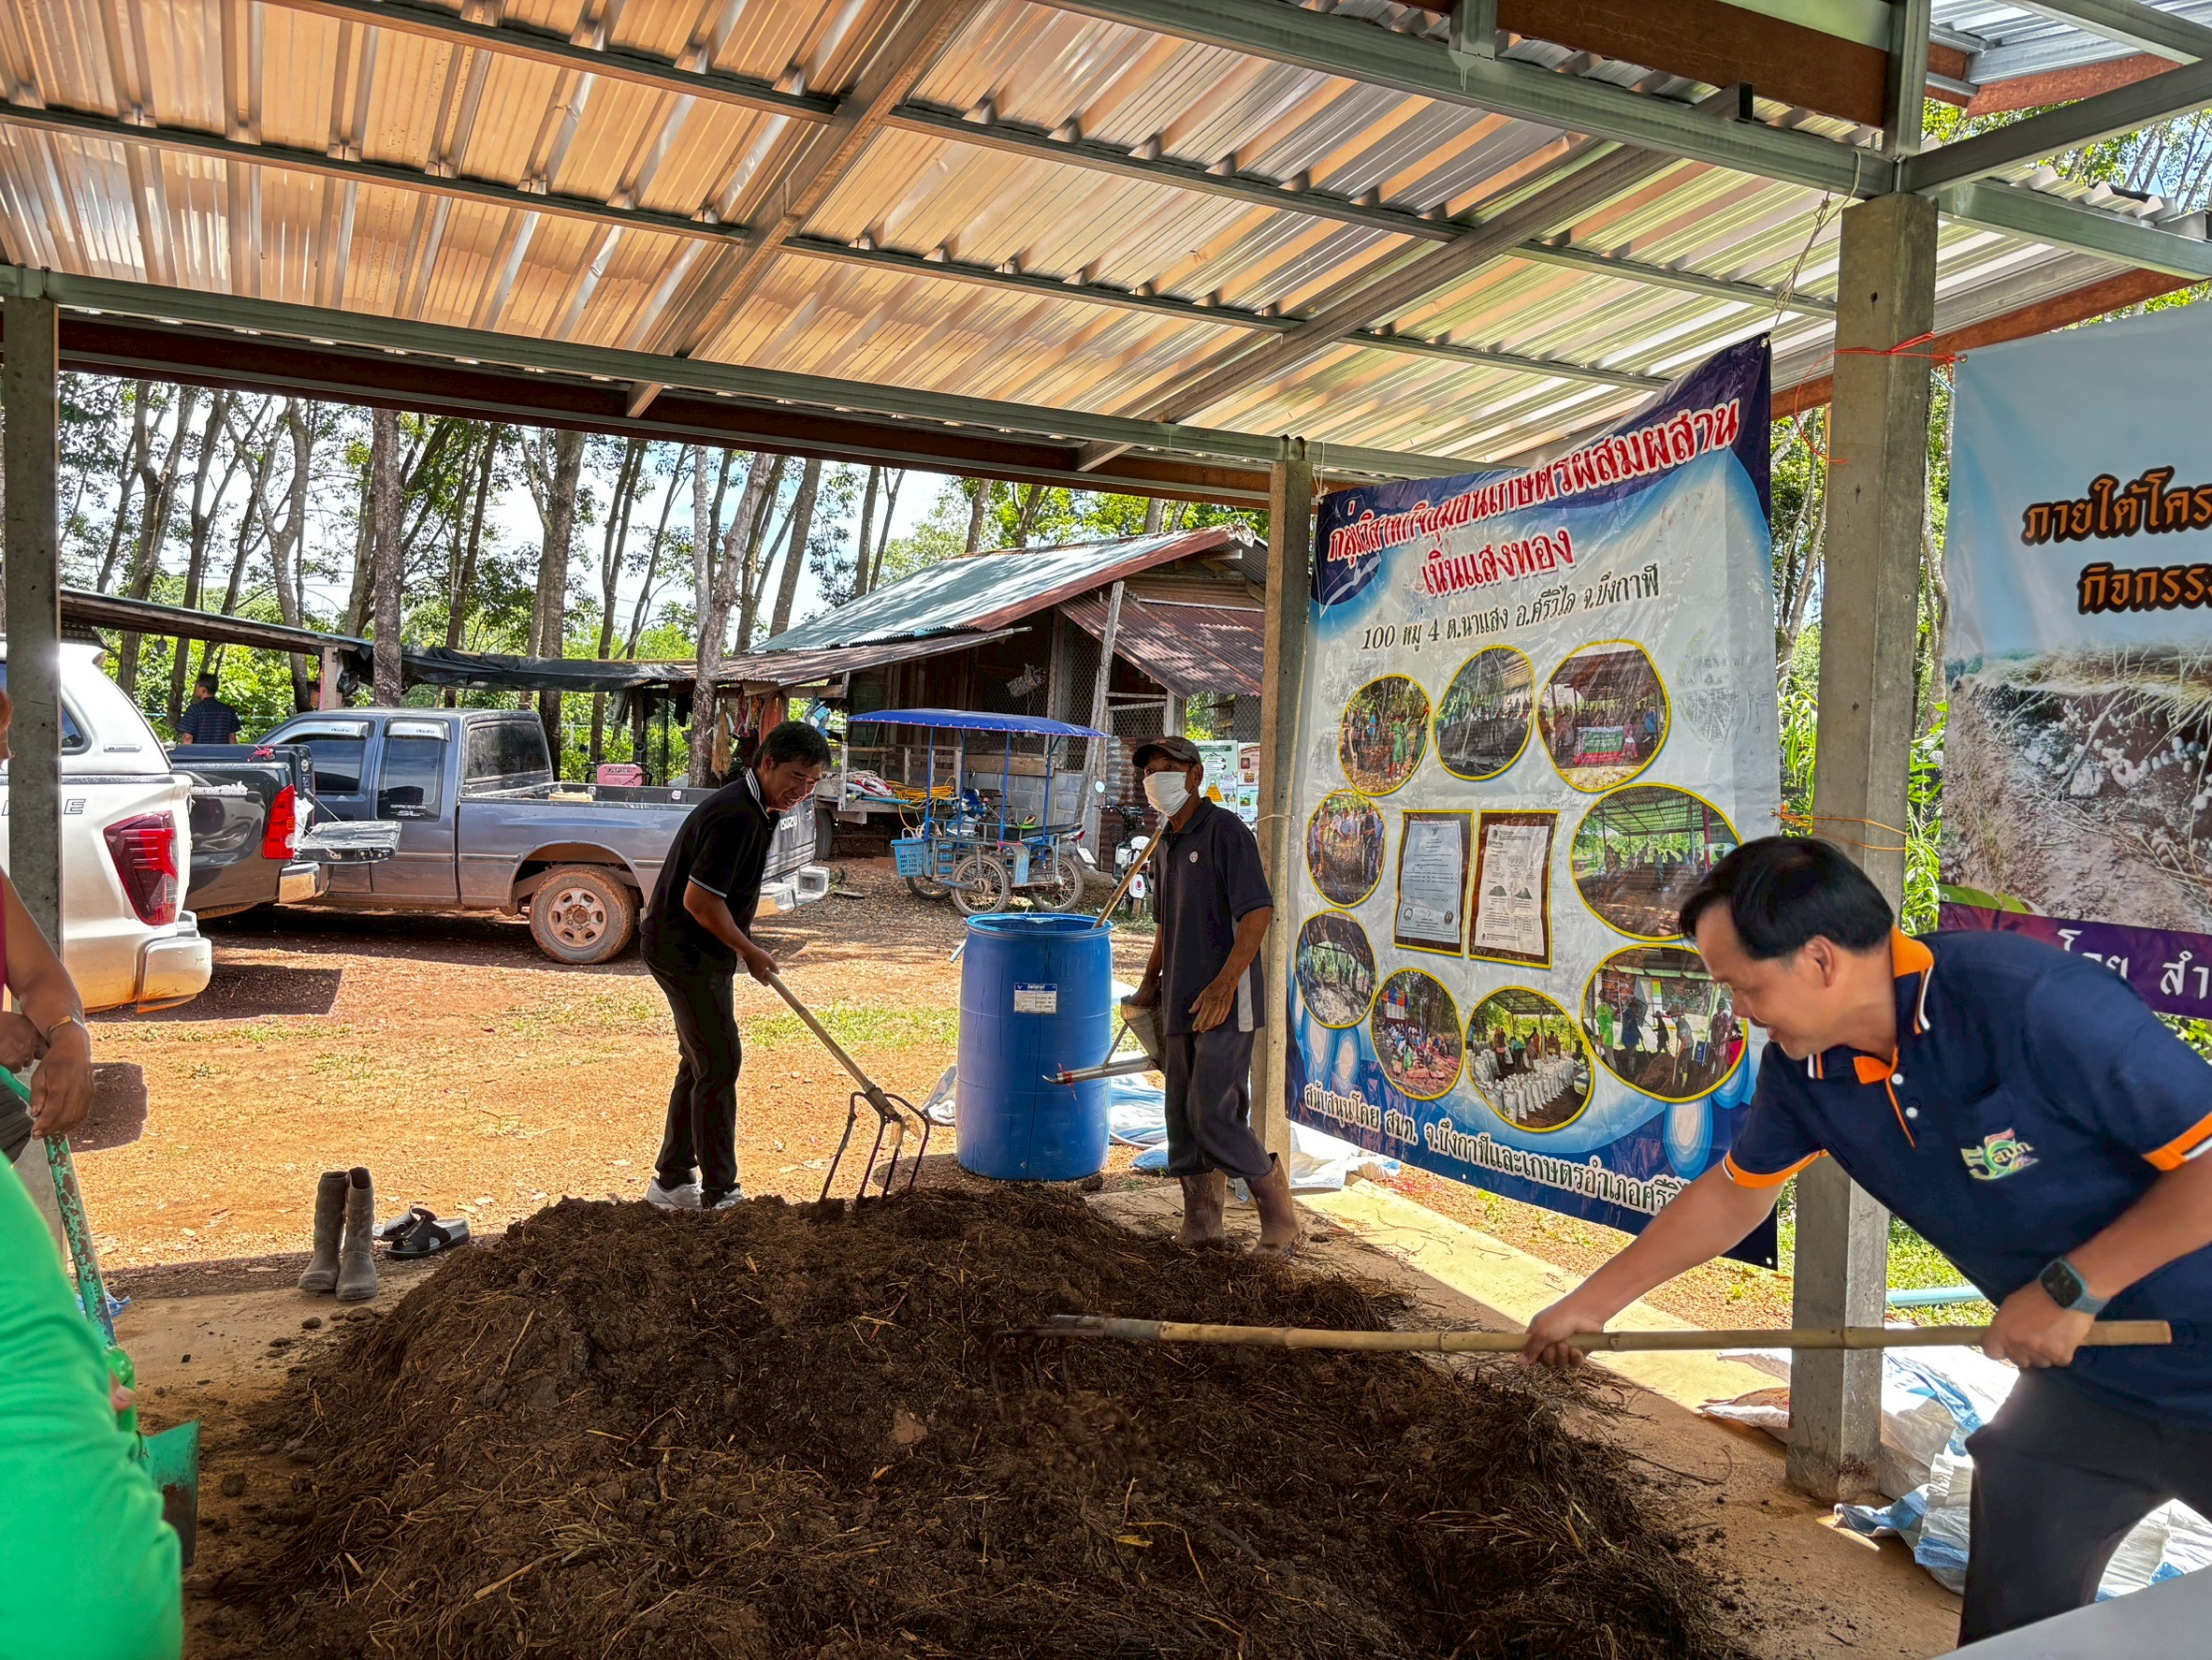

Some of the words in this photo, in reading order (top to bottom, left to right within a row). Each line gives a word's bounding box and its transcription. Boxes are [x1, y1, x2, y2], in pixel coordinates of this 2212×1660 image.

[1421, 529, 1575, 595] เนินแสงทอง
[1361, 625, 1396, 650] 100
[1428, 618, 1440, 642] 4
[1447, 607, 1508, 639] ต.นาแสง
[1516, 585, 1576, 628] อ.ศรีวิไล
[1583, 562, 1659, 610] จ.บึงกาฬ
[2079, 564, 2212, 610] กิจกรร
[780, 815, 797, 831] ISUZU
[2160, 950, 2212, 1000] สำ
[1305, 1081, 1379, 1129] สนับสนุนโดย
